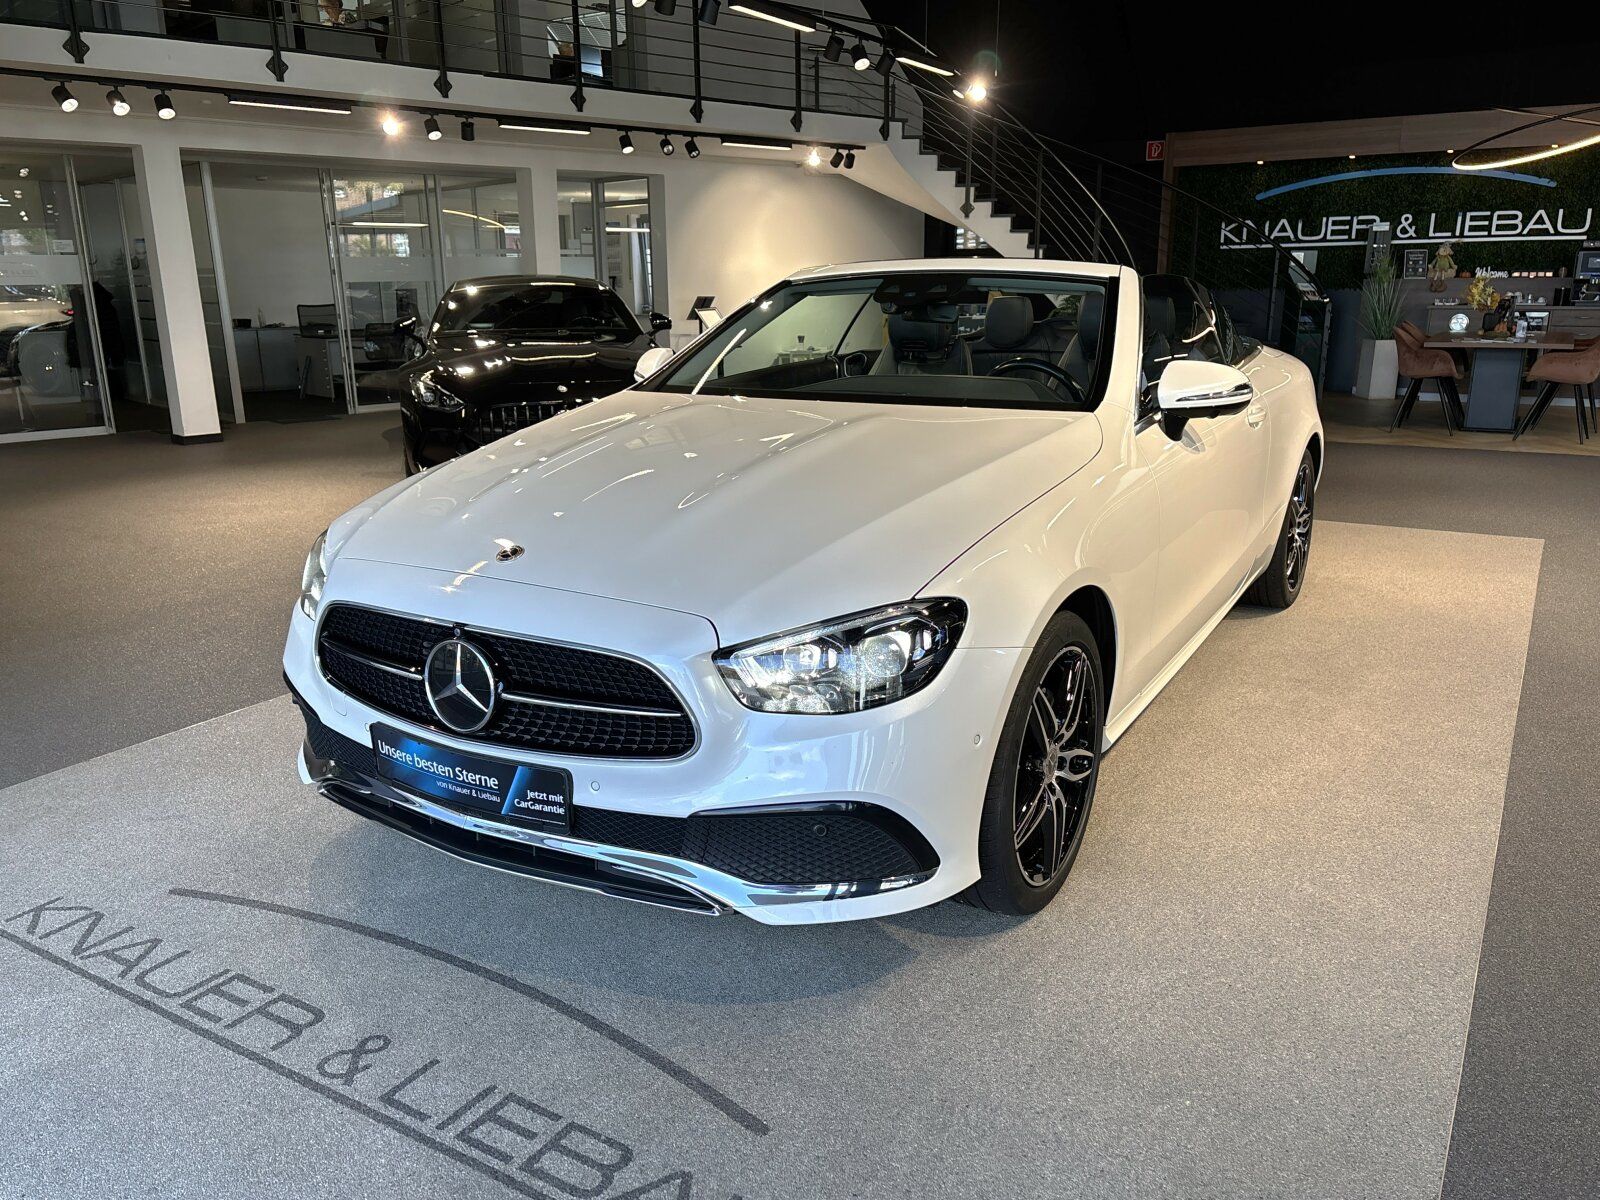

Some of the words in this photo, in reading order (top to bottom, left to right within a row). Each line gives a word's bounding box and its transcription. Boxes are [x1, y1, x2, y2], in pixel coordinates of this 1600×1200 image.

[1219, 214, 1381, 245] KNAUER
[1396, 213, 1417, 239] &
[1428, 207, 1593, 238] LIEBAU
[1475, 265, 1509, 279] Welcome
[378, 739, 413, 765] Unsere
[413, 753, 454, 779] besten
[455, 767, 499, 790] Sterne
[436, 780, 448, 789] von
[448, 783, 470, 797] Knauer
[471, 789, 477, 798] &
[477, 790, 501, 803] Liebau
[526, 789, 547, 801] Jetzt
[548, 792, 564, 804] mit
[514, 798, 566, 815] CarGarantie
[5, 896, 326, 1051] KNAUER
[315, 1034, 391, 1086] &
[378, 1058, 743, 1200] LIEBA
